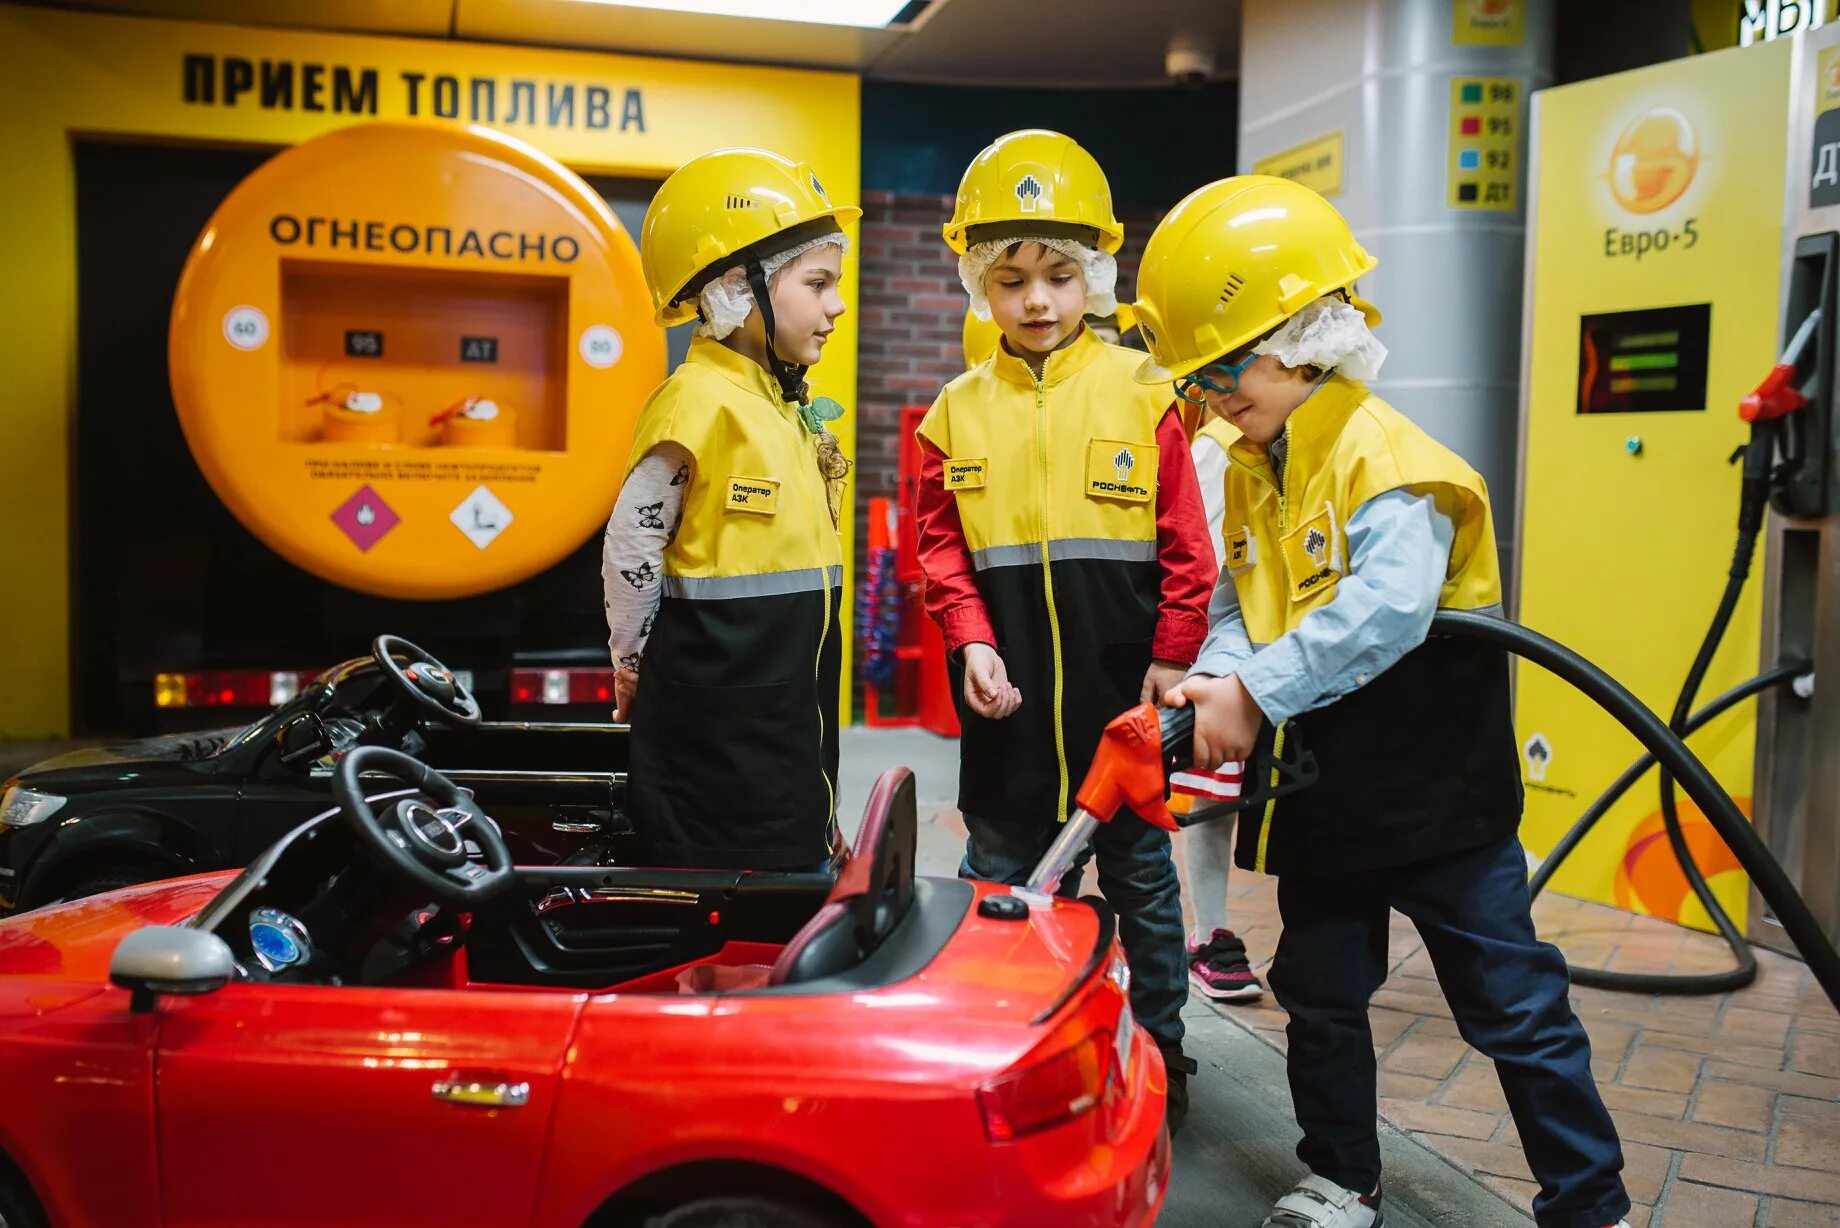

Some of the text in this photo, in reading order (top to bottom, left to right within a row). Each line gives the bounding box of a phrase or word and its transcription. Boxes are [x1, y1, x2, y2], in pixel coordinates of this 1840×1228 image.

[182, 53, 647, 132] ПРИЕМ ТОПЛИВА
[1486, 150, 1510, 170] 92
[1813, 141, 1840, 189] Д
[269, 214, 580, 263] ОГНЕОПАСНО
[950, 465, 982, 474] Оператор
[951, 474, 965, 483] АЗК
[732, 483, 772, 497] Оператор
[1092, 480, 1148, 496] РОСНЕФТЬ
[731, 494, 748, 504] АЗК
[1298, 567, 1334, 592] РОСНЕ
